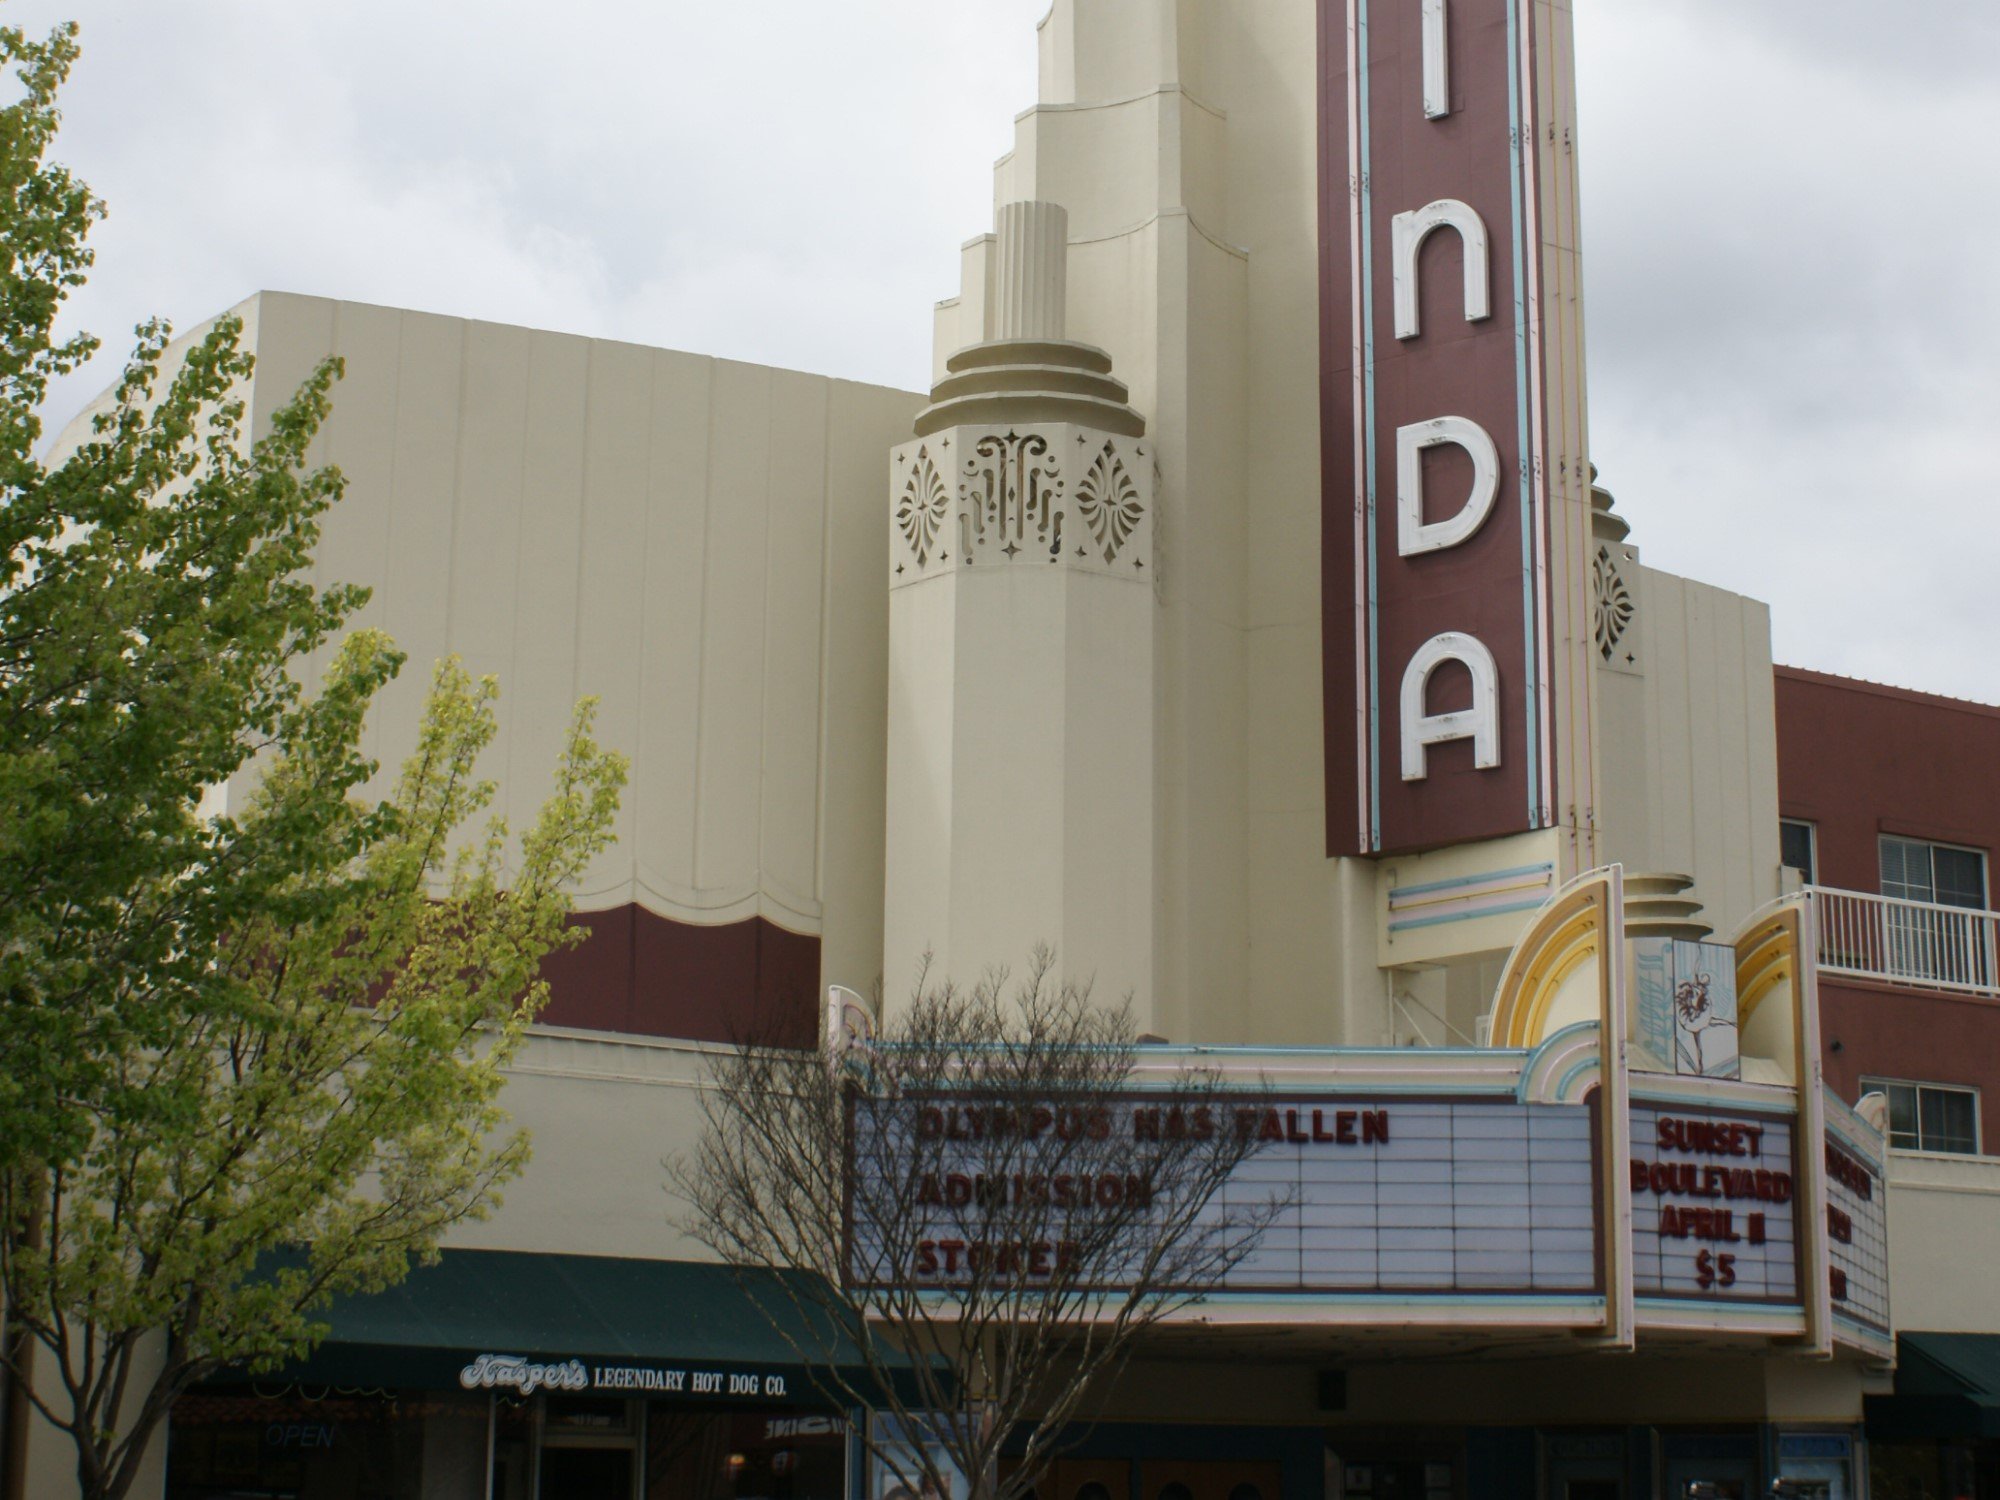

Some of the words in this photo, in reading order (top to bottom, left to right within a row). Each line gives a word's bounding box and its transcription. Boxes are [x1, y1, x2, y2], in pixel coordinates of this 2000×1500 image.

[1133, 1107, 1214, 1142] HAS
[1236, 1108, 1389, 1143] FALLEN
[1657, 1117, 1763, 1158] SUNSET
[1630, 1159, 1793, 1204] BOULEVARD
[1660, 1205, 1741, 1242] APRIL
[1696, 1248, 1736, 1289] $5
[460, 1353, 589, 1396] Kasper's
[594, 1367, 685, 1391] LEGENDARY
[692, 1372, 723, 1393] HOT
[729, 1374, 758, 1394] DOG
[765, 1376, 787, 1396] CO.
[265, 1422, 337, 1449] OPEN
